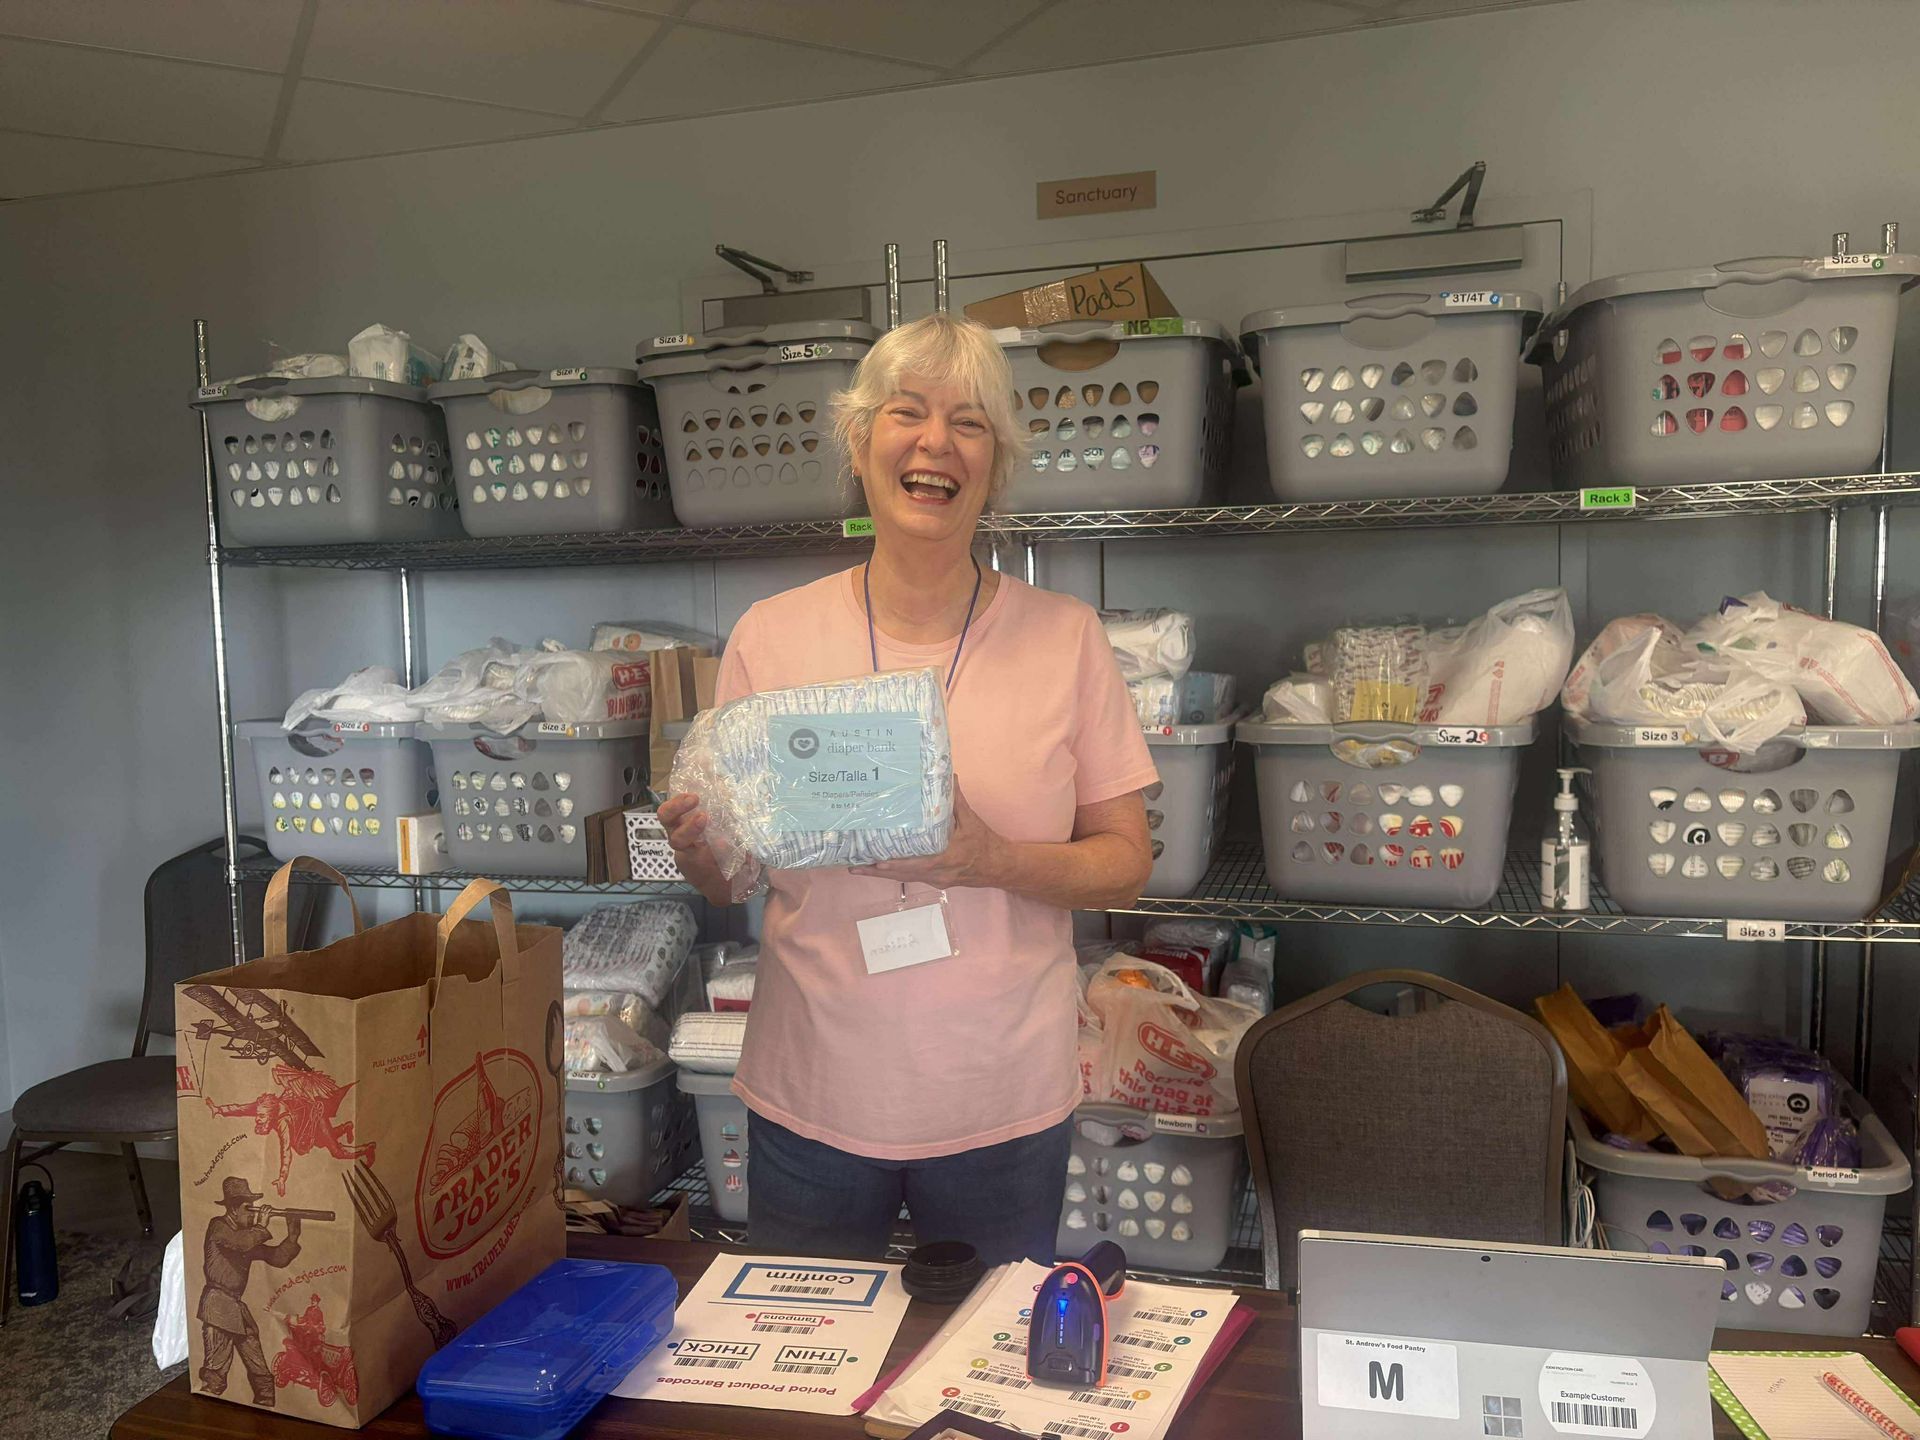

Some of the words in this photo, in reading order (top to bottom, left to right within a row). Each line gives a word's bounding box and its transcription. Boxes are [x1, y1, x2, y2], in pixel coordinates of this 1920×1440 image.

[1055, 185, 1137, 205] Sanctuary
[1452, 293, 1486, 303] 3T/4T
[782, 347, 803, 361] Size
[804, 345, 814, 358] 5
[1590, 493, 1620, 504] Rack
[1623, 493, 1630, 503] 3
[850, 523, 872, 532] Rack
[542, 723, 559, 731] Size
[560, 724, 566, 732] 3
[1439, 729, 1461, 743] Size
[1466, 730, 1482, 744] 2
[1642, 731, 1668, 741] Size
[1671, 731, 1679, 741] 3
[827, 742, 864, 755] diaper
[867, 741, 897, 753] bank
[809, 770, 867, 782] Size/Talla
[872, 766, 880, 780] 1
[1740, 927, 1765, 937] Size
[1768, 928, 1776, 938] 3
[400, 1060, 416, 1070] OUT
[1119, 1067, 1146, 1093] this
[1152, 1084, 1189, 1107] bag
[1193, 1095, 1214, 1108] at
[1157, 1117, 1193, 1130] Newborn
[433, 1113, 532, 1225] TRADER
[1812, 1171, 1838, 1179] Period
[443, 1156, 521, 1242] JOE'S
[766, 1271, 855, 1285] Confirm
[763, 1314, 818, 1324] Tampons
[683, 1342, 749, 1356] THICK
[1356, 1340, 1385, 1348] Andrew's
[1404, 1344, 1426, 1352] Pantry
[785, 1349, 837, 1362] THIN
[656, 1376, 725, 1388] Barcodes
[728, 1381, 786, 1392] Product
[1369, 1361, 1404, 1402] M
[789, 1385, 837, 1396] Period
[1560, 1390, 1590, 1400] Example
[1591, 1393, 1626, 1403] Customer
